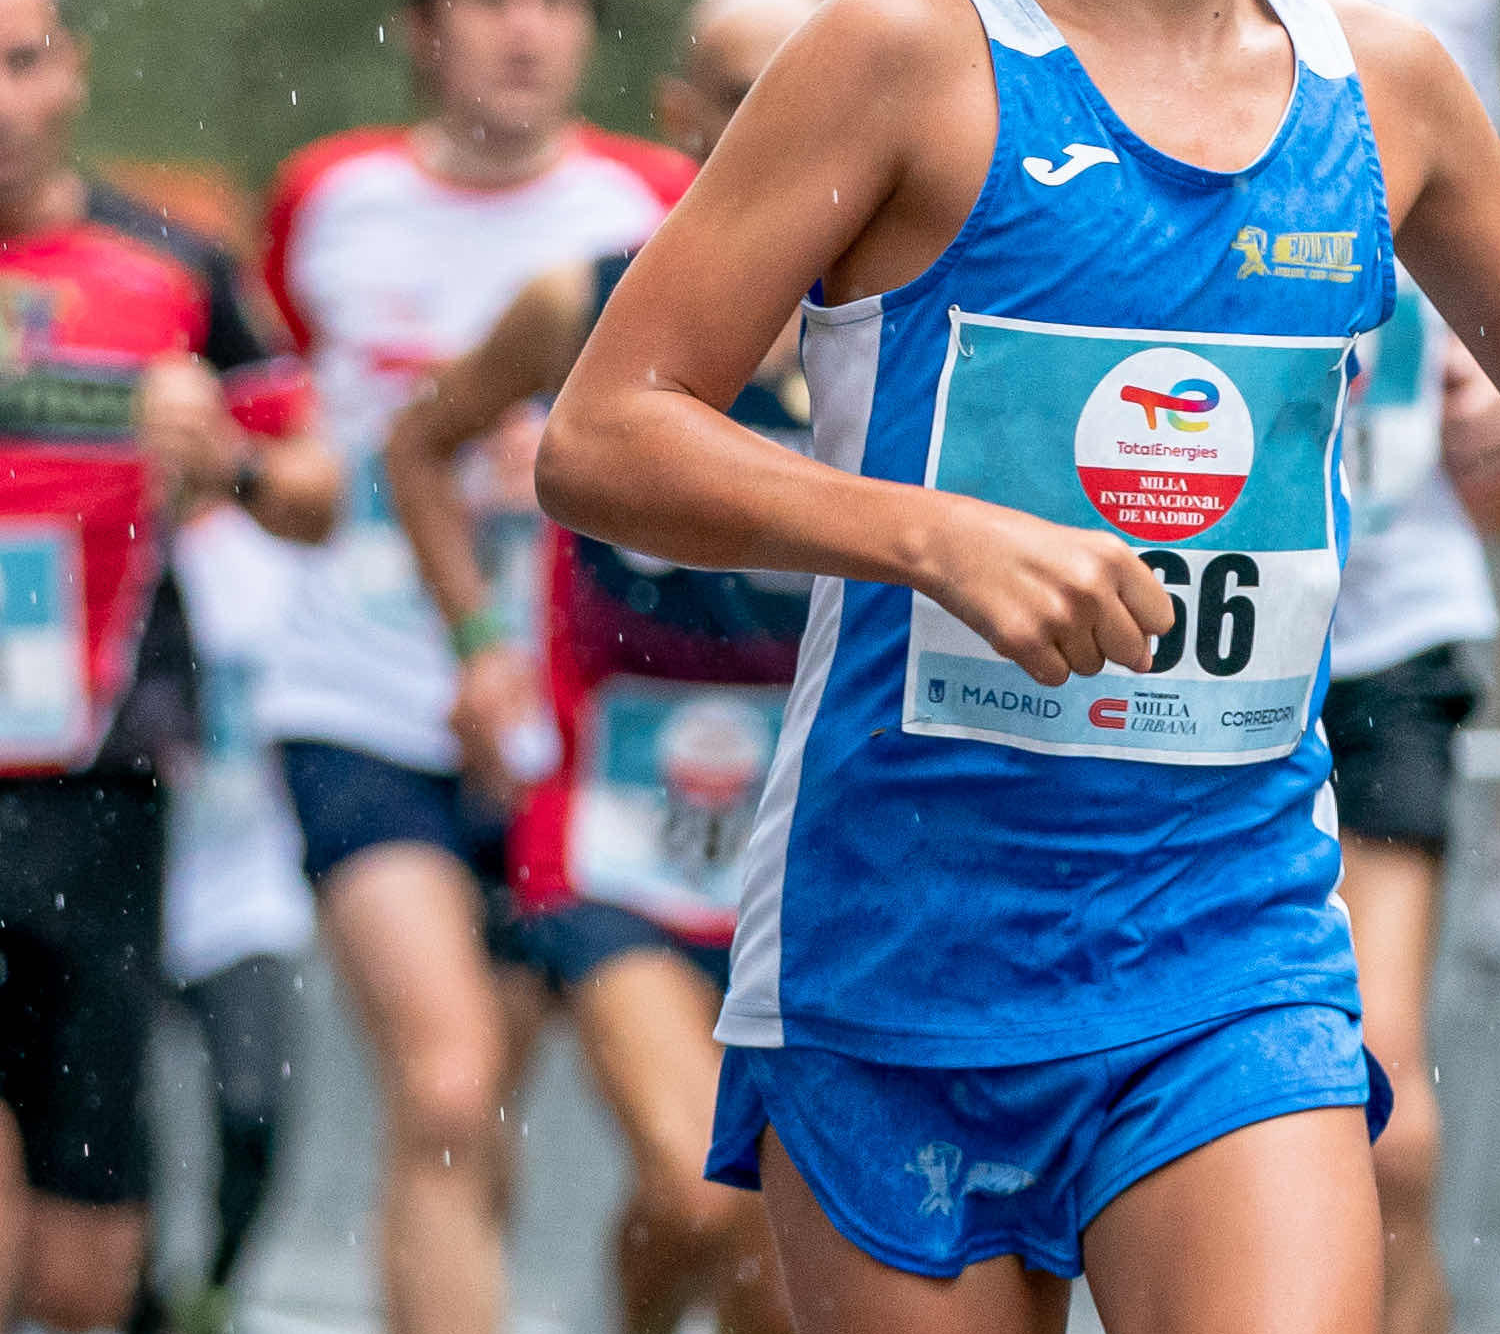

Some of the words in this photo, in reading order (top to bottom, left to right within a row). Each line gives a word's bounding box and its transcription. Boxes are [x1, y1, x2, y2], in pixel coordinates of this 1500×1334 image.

[1117, 441, 1218, 461] TotalEnergies
[1139, 476, 1188, 492] MILLA
[1118, 509, 1141, 522] DE
[1144, 510, 1205, 526] MADRID
[962, 685, 1062, 719] MADRID
[1133, 700, 1190, 718] MILLA
[1130, 717, 1199, 735] URBANA
